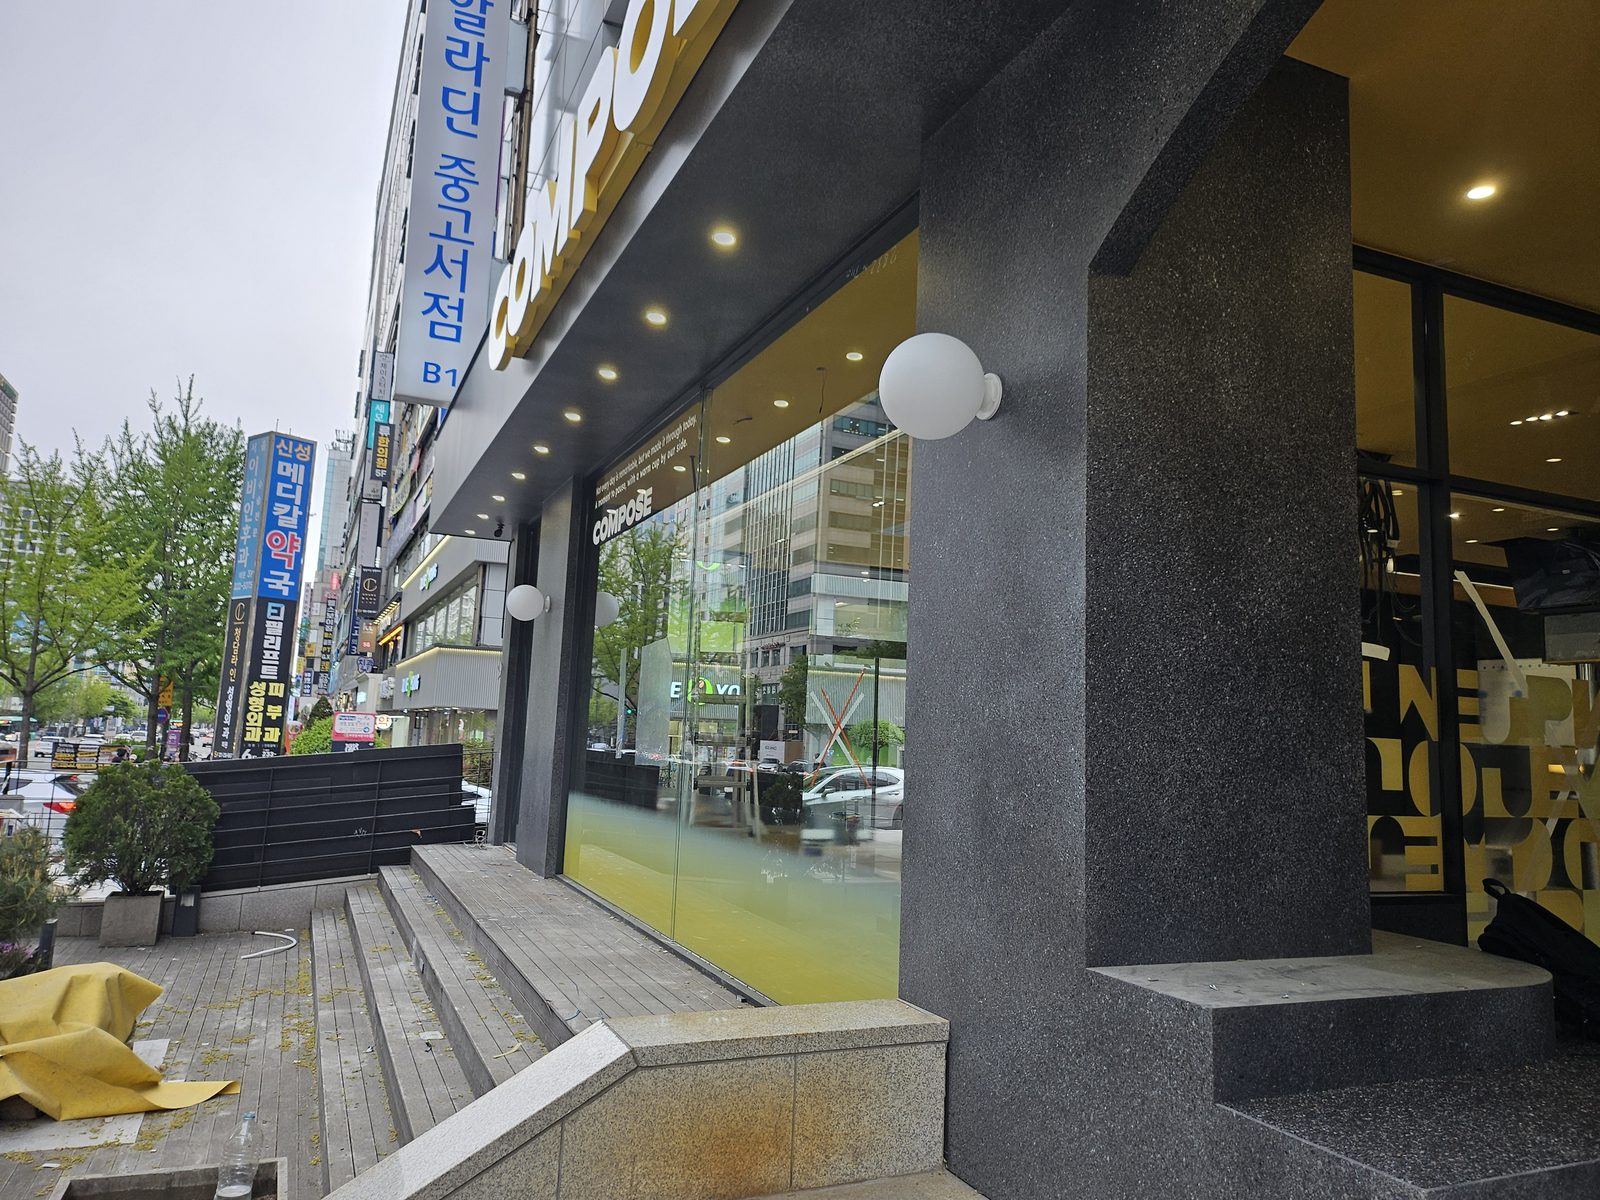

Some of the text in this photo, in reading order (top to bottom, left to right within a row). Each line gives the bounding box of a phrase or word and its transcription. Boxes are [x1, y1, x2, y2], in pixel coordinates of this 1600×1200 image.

[421, 153, 480, 344] 중고서점
[422, 361, 458, 388] B1
[276, 439, 311, 461] 신성
[237, 456, 259, 568] 이비인후과
[593, 486, 653, 545] COMPOSE
[244, 681, 267, 742] 성형외과
[263, 682, 285, 743] 피부과
